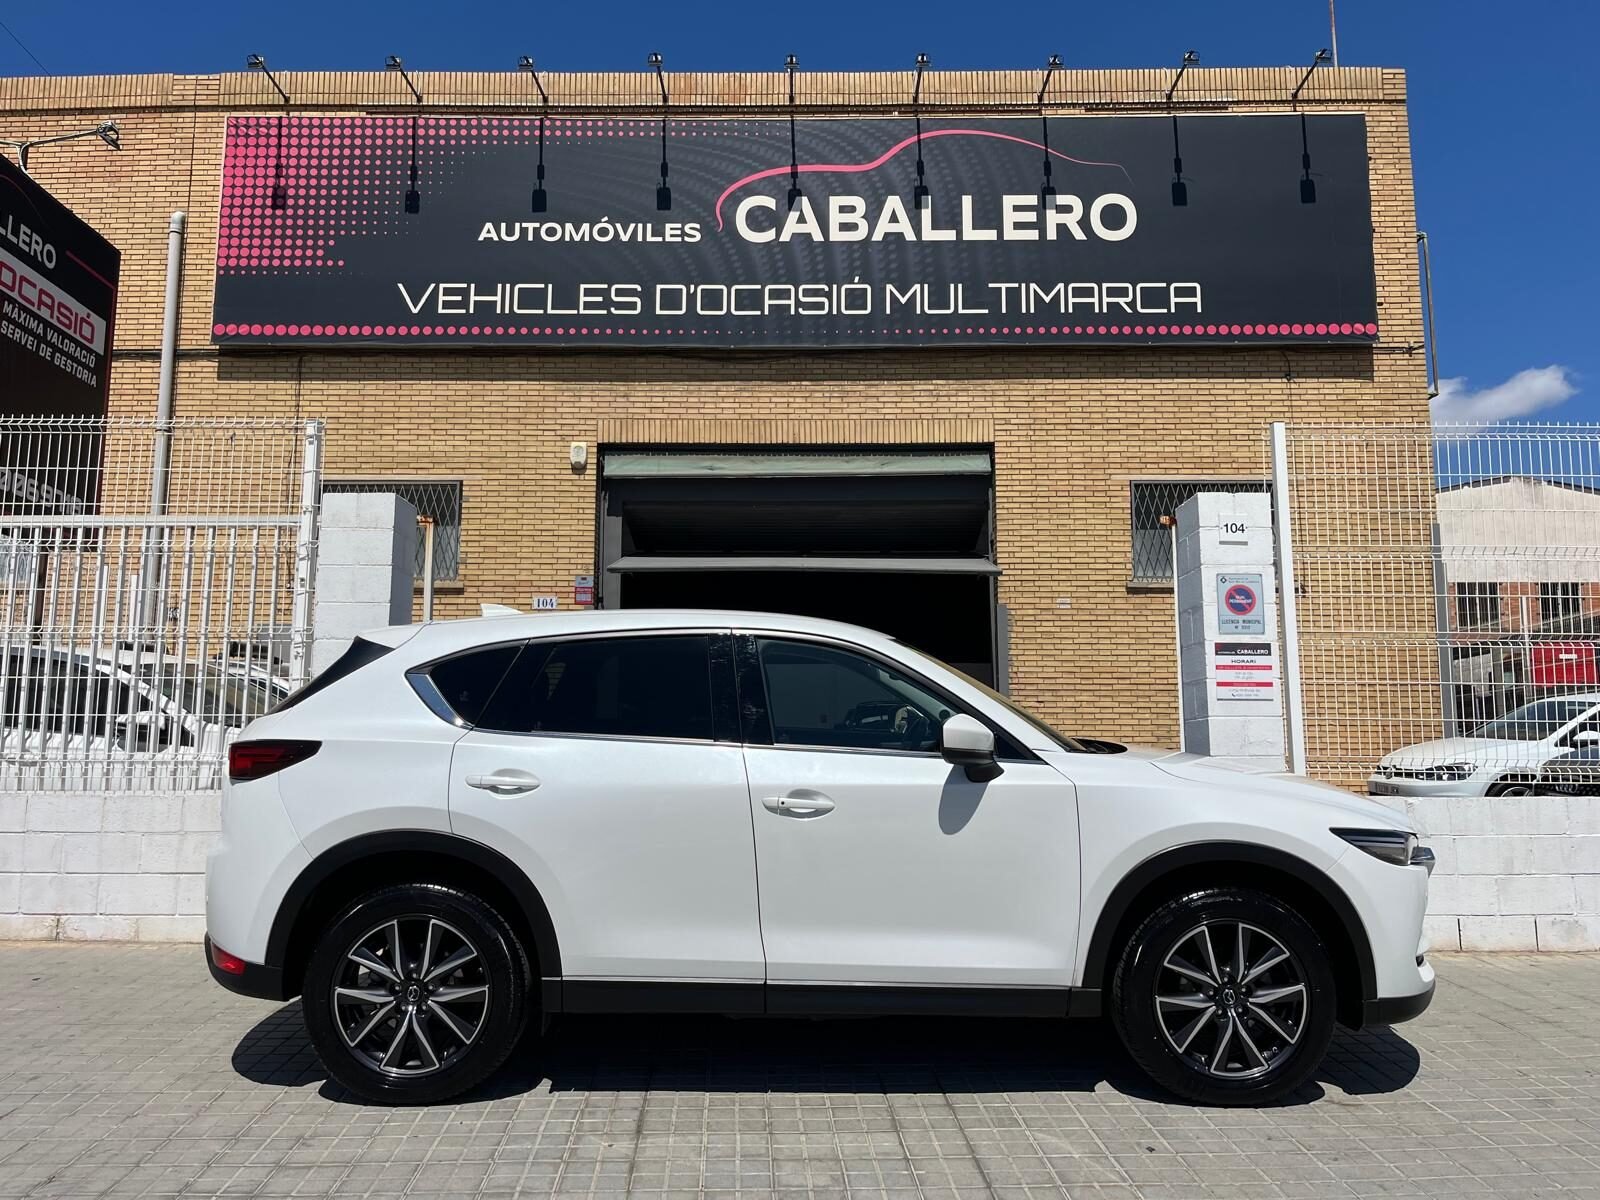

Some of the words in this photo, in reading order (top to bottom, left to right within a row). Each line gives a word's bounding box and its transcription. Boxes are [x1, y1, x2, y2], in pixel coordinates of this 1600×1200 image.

[478, 216, 702, 243] AUTOMÓVILES
[735, 193, 1138, 244] CABALLERO
[397, 282, 642, 315] VEHICLES
[655, 276, 872, 316] D'OCASIÓ
[885, 282, 1202, 315] MULTIMARCA
[0, 320, 37, 352] SERVEI
[39, 345, 51, 361] DE
[54, 351, 97, 388] GESTORIA
[47, 327, 96, 369] VALORACIÓ
[537, 598, 554, 608] 104
